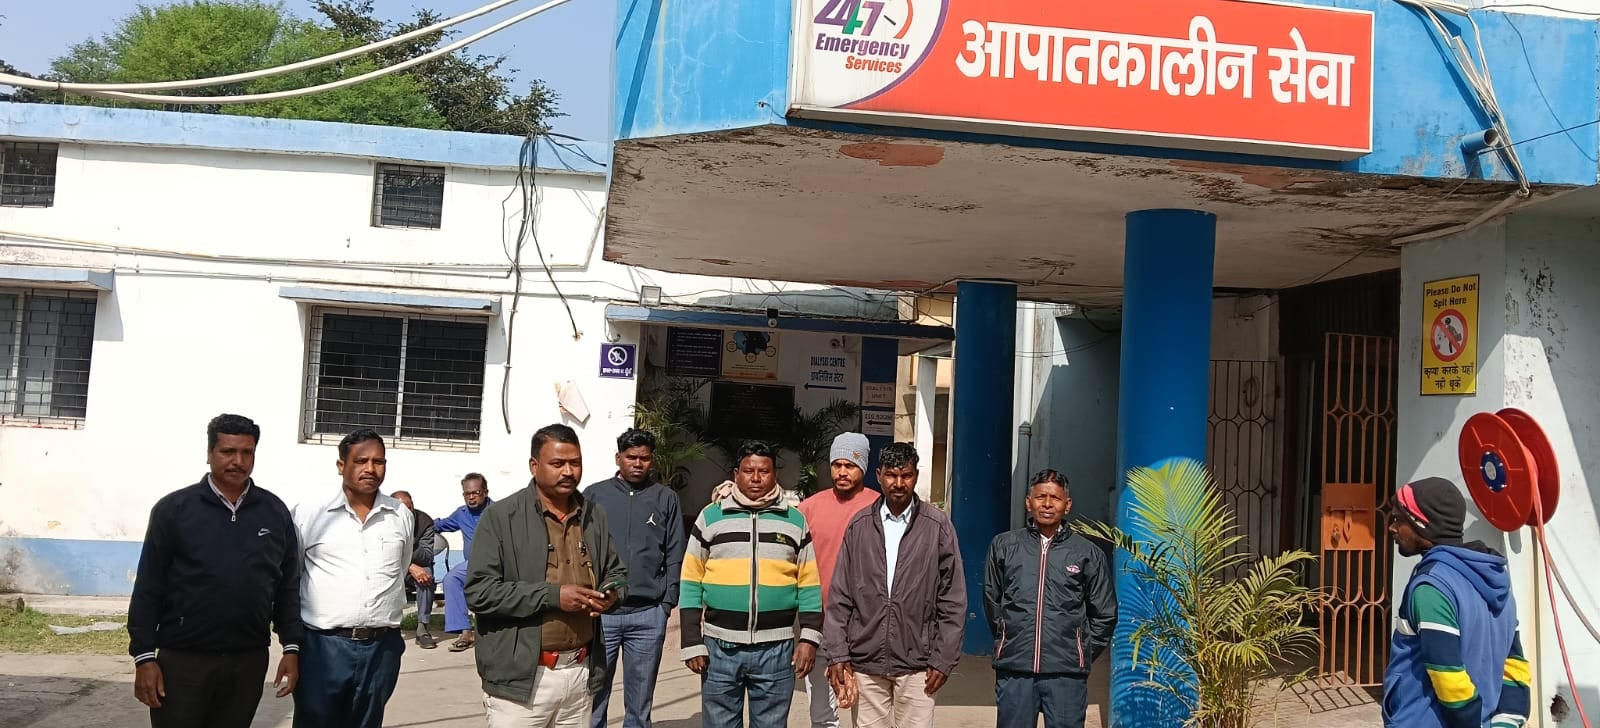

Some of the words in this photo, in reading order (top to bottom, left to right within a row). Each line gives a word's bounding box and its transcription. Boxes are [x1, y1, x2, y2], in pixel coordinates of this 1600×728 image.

[815, 33, 910, 59] Emergency
[845, 55, 902, 73] Services
[955, 15, 1257, 99] आपातकालीन
[1267, 26, 1355, 107] सेवा
[1426, 287, 1449, 297] Please
[1451, 284, 1461, 293] Do
[1463, 281, 1477, 292] Not
[1433, 299, 1447, 309] Spit
[1449, 297, 1467, 305] Here
[829, 357, 846, 368] CENTRE
